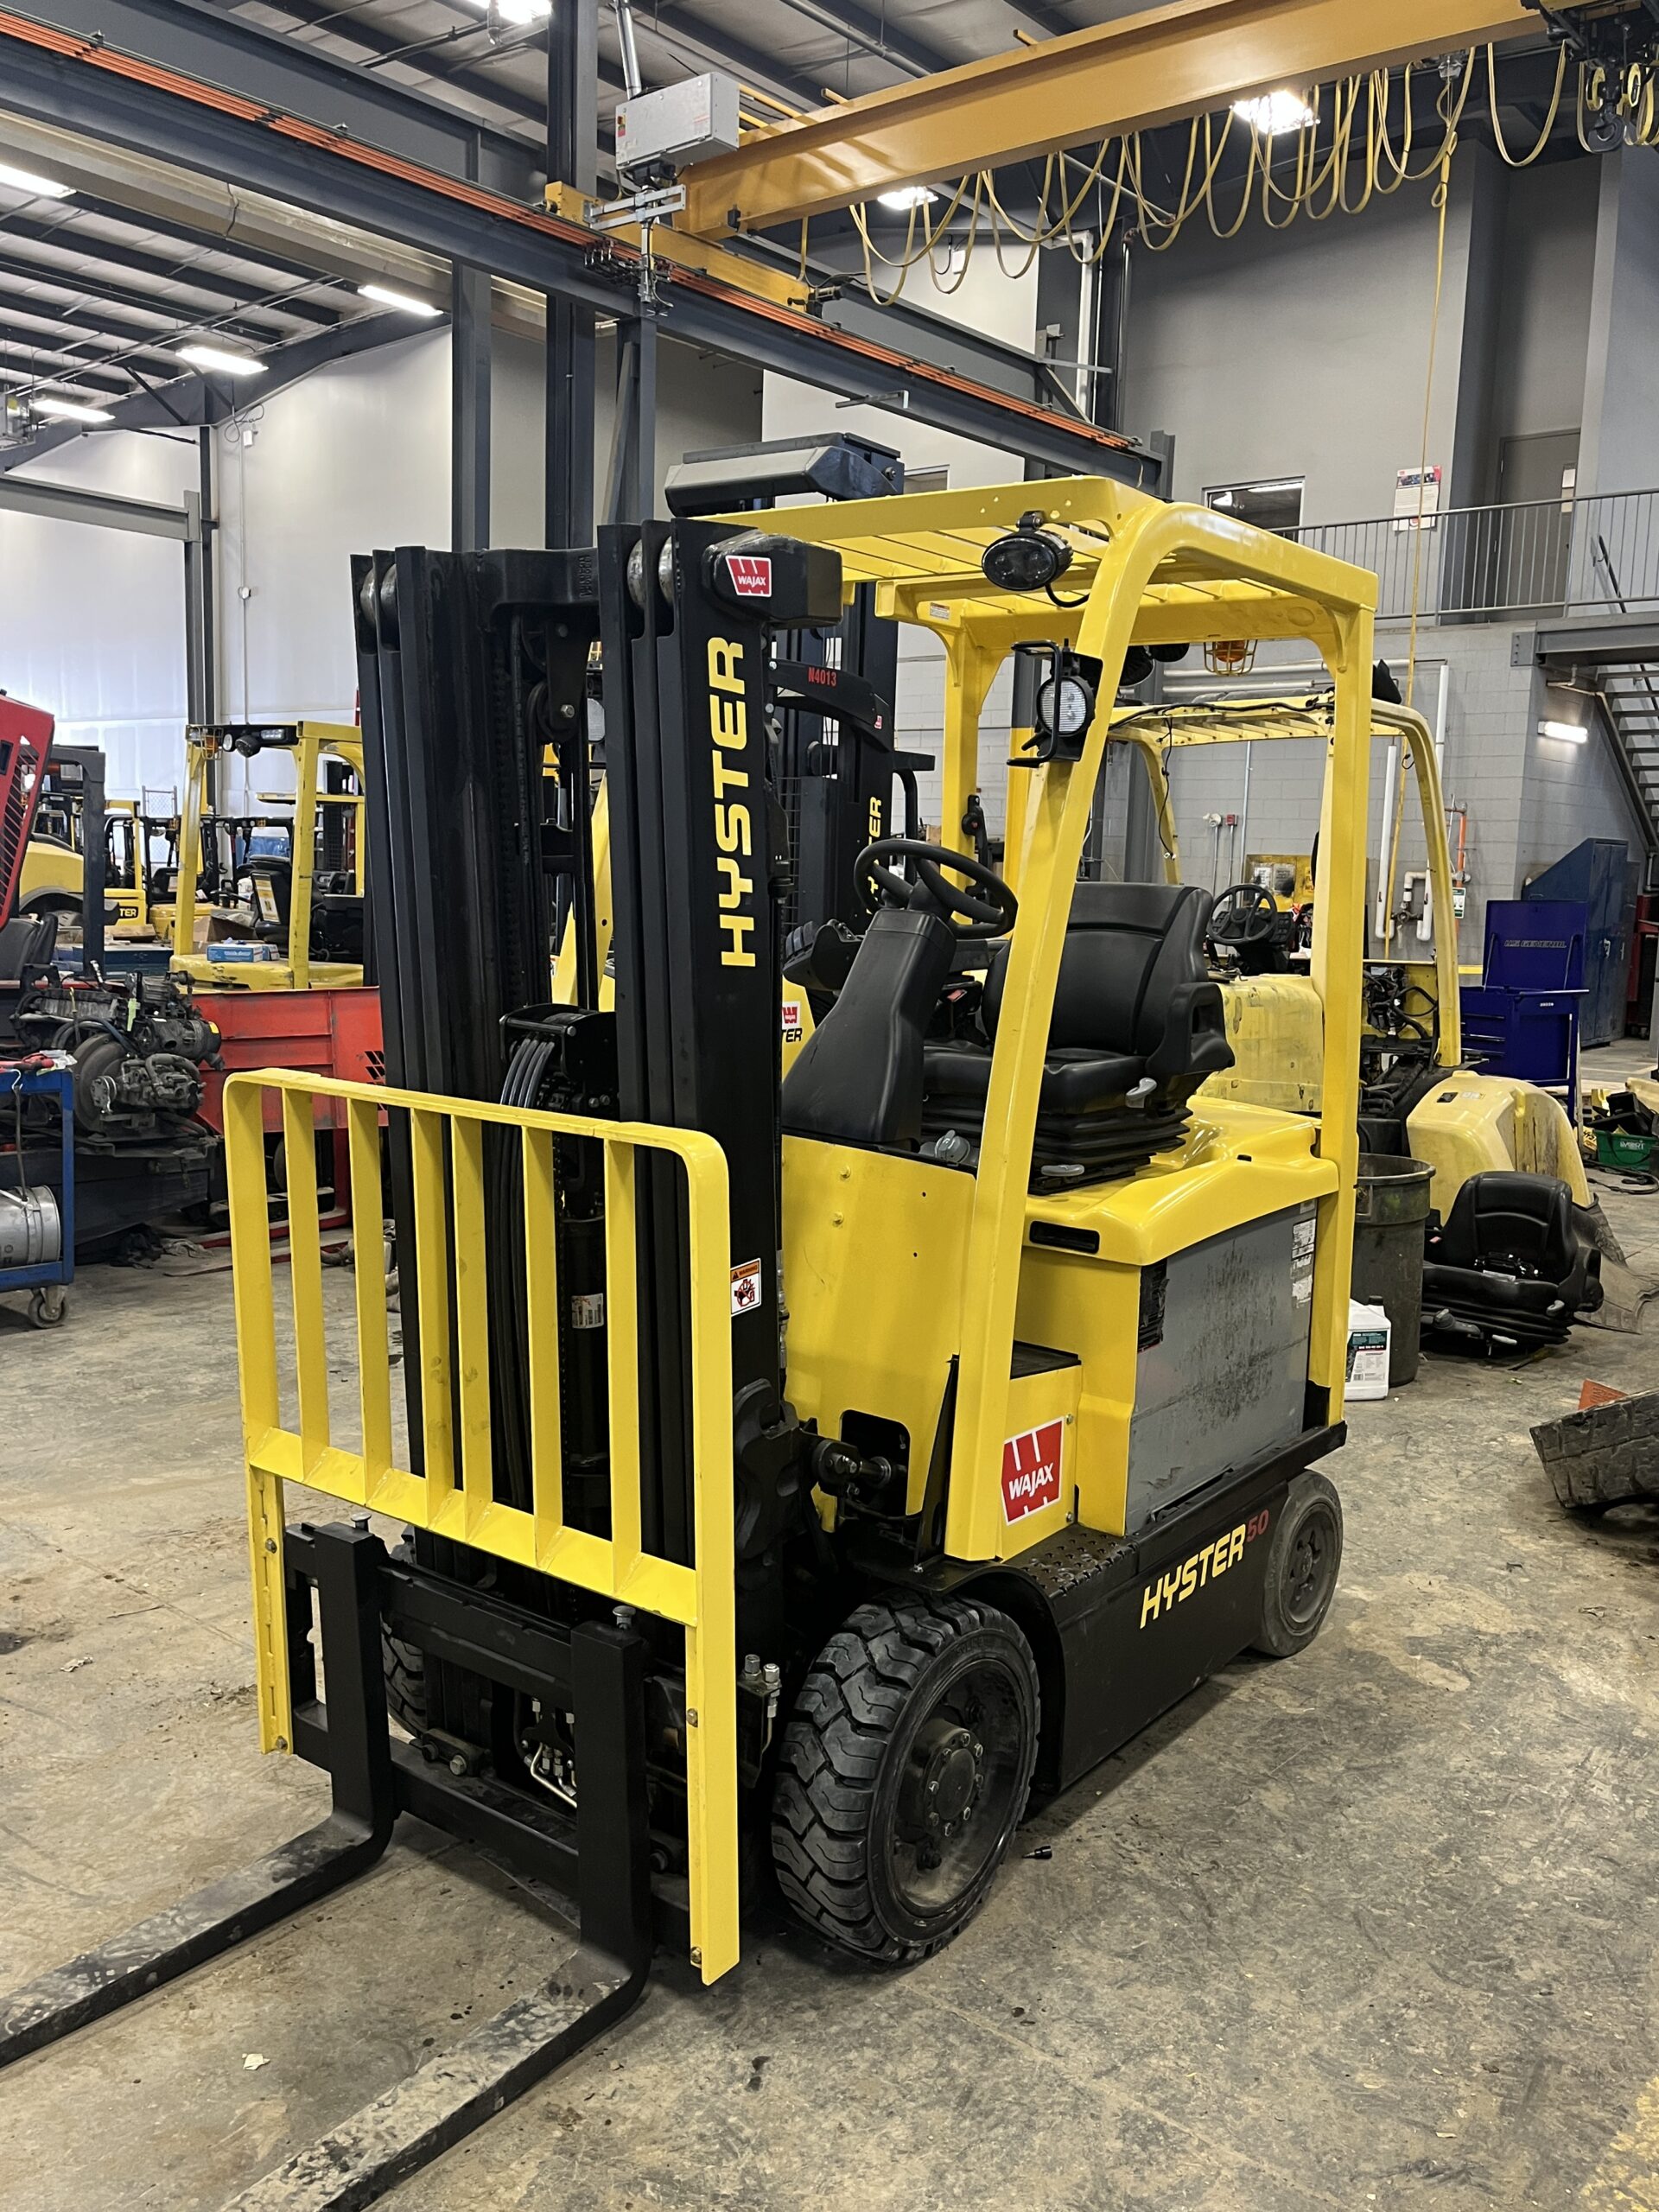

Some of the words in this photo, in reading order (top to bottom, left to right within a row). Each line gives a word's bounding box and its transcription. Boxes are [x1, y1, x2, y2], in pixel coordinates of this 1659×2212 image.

[737, 575, 766, 588] WAJAX
[808, 666, 837, 687] N4013
[707, 637, 756, 967] HYSTER
[1008, 1462, 1054, 1501] WAJAX
[1139, 1523, 1247, 1630] HYSTER
[1246, 1509, 1269, 1543] 50
